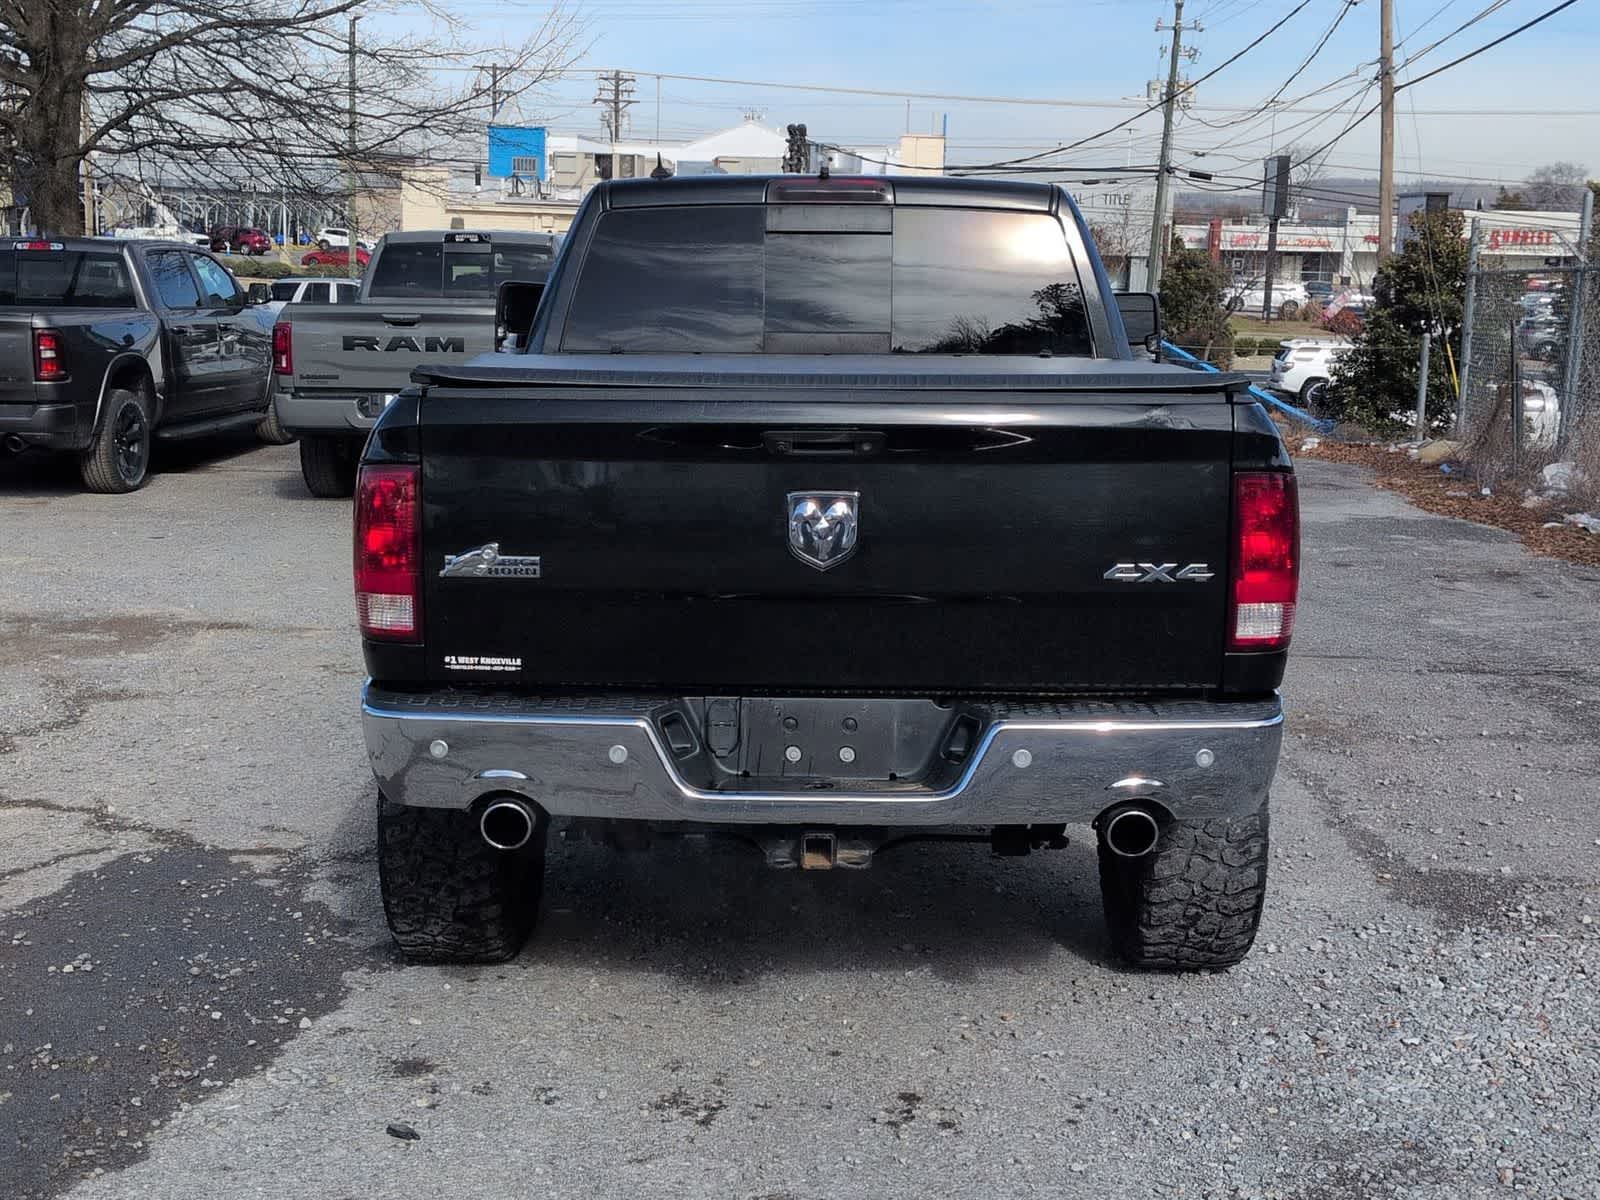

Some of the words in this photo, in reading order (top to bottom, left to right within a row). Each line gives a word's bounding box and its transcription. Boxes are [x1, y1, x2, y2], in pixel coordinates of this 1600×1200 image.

[1103, 193, 1130, 206] TITLE
[342, 336, 465, 352] RAM
[487, 567, 537, 576] HORN
[444, 655, 457, 664] #1
[457, 656, 480, 665] WEST
[480, 656, 522, 666] KNOXVILLE
